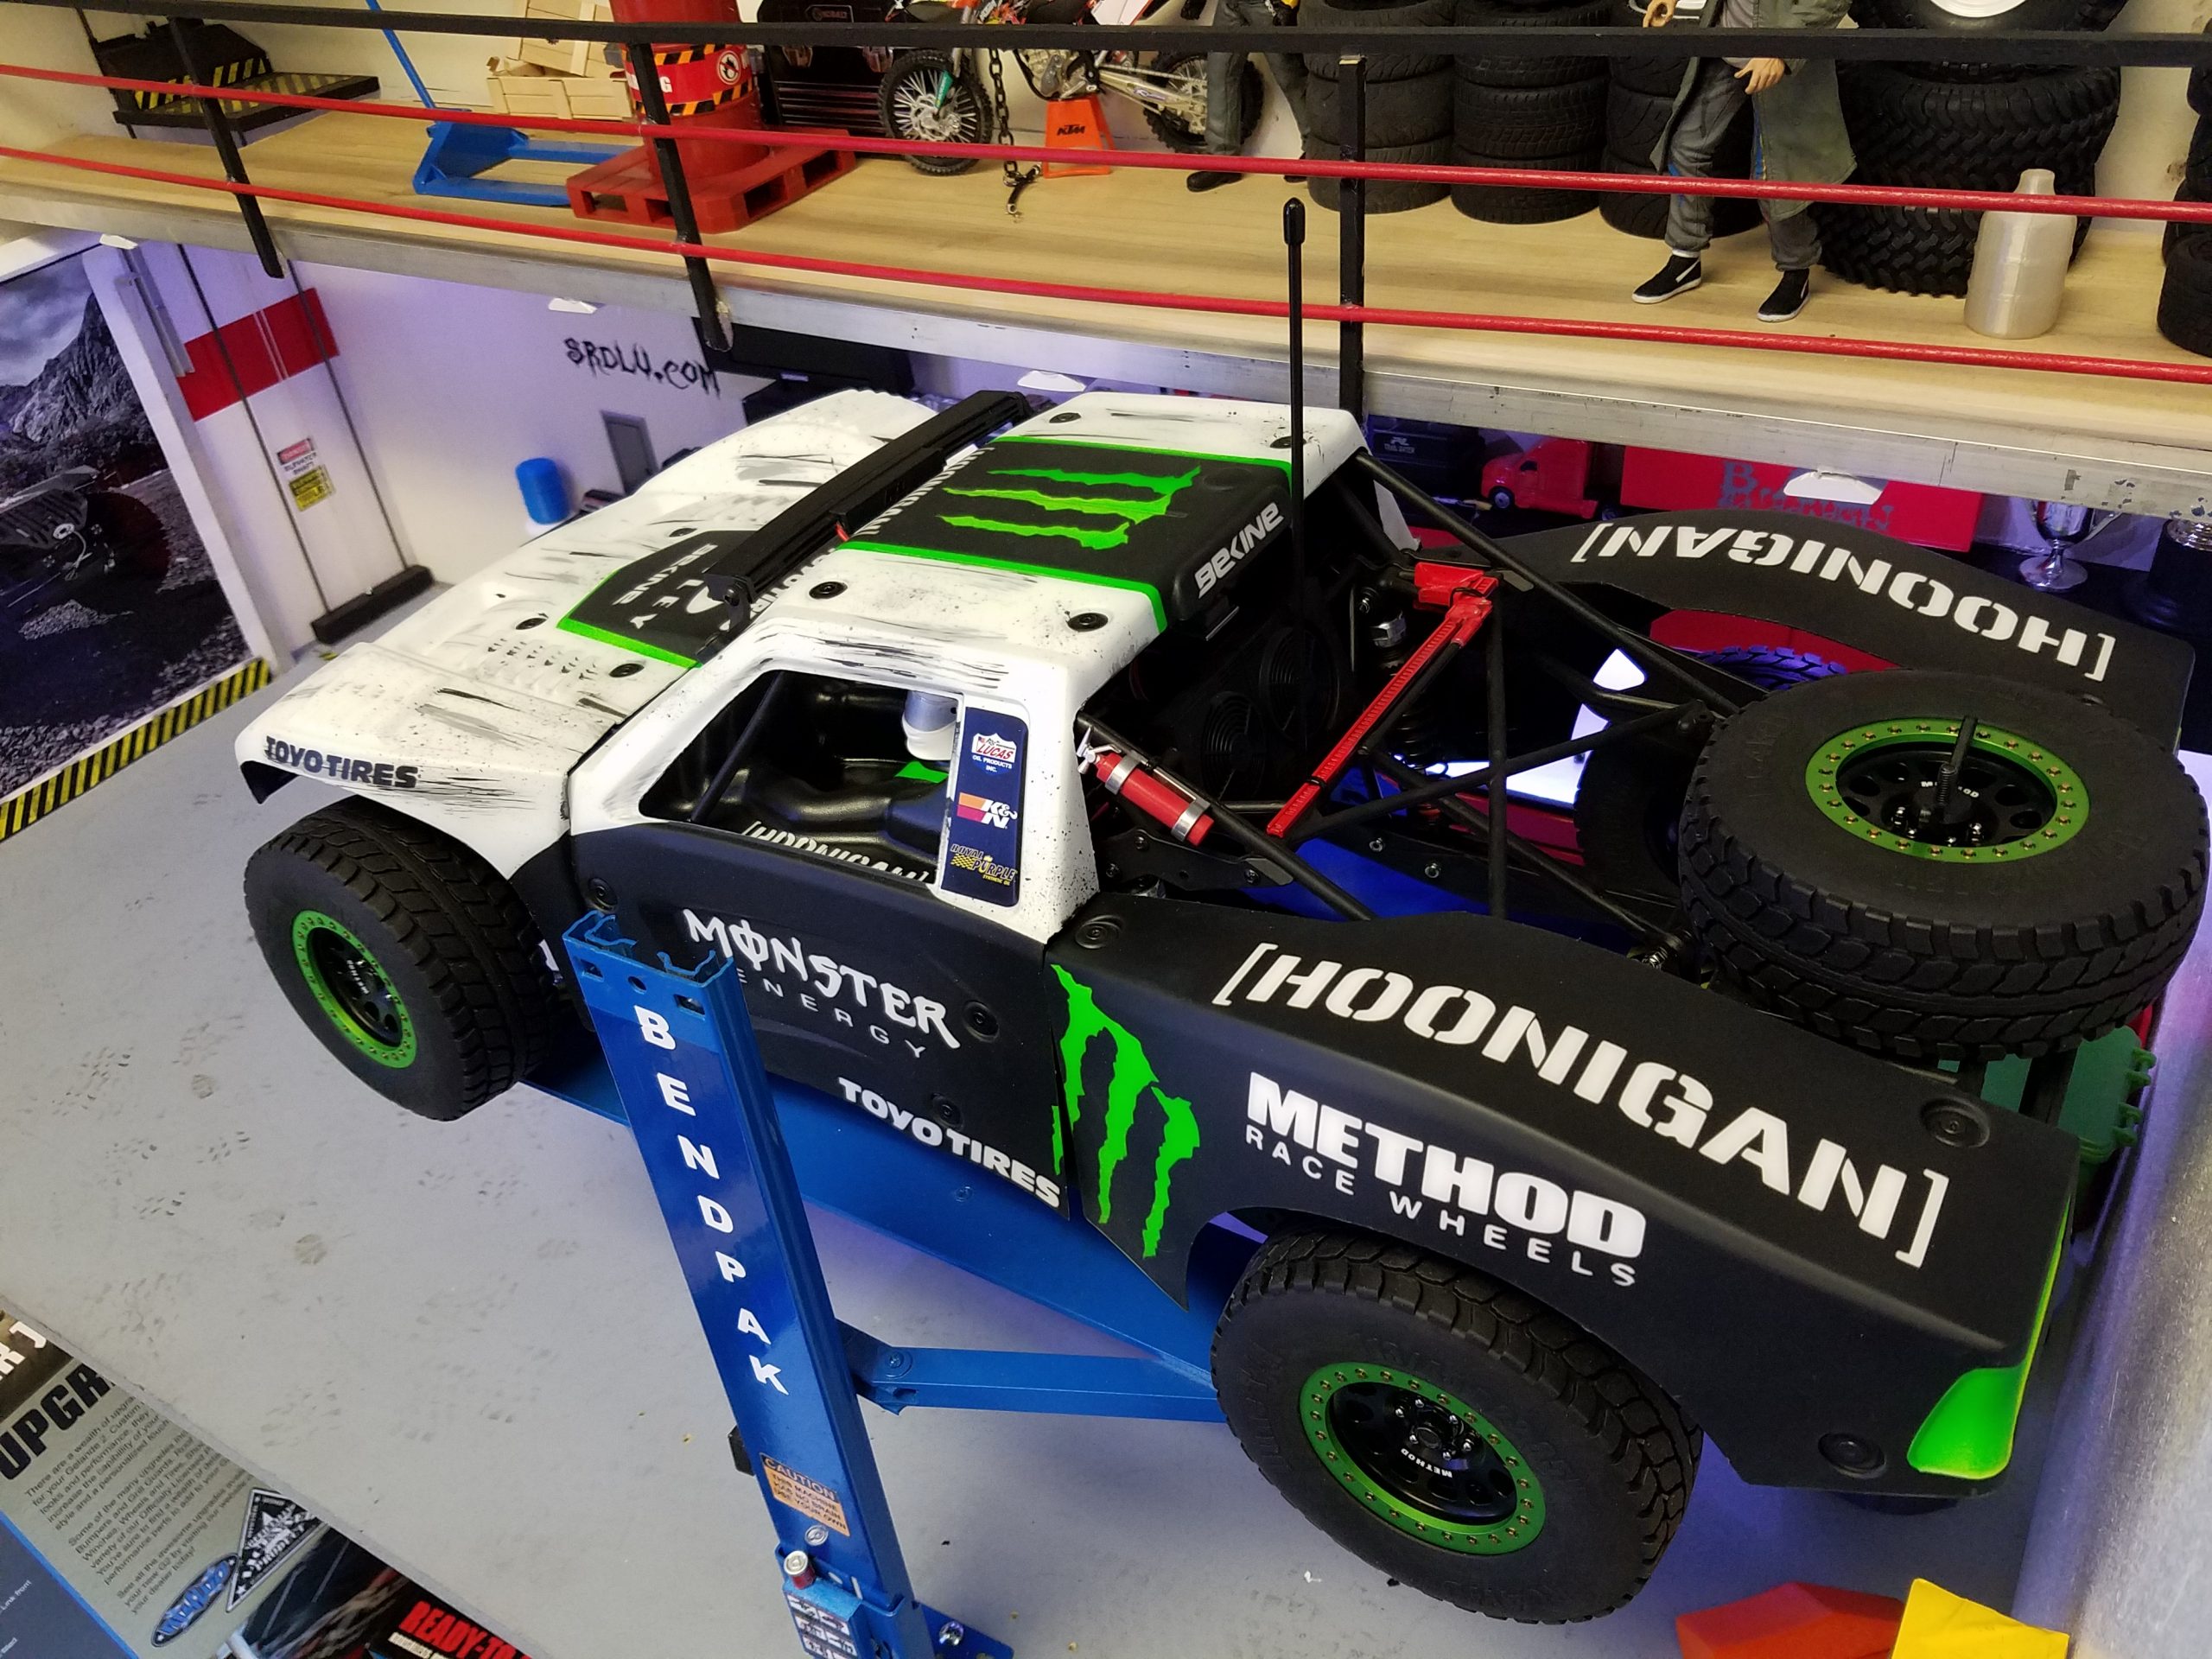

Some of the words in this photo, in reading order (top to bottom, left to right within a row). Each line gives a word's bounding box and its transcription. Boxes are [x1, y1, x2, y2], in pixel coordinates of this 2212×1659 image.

[1057, 124, 1085, 137] KTM
[976, 744, 1014, 760] LUCAS
[982, 757, 1012, 769] PRODUCTS
[982, 799, 1018, 829] K&N
[950, 843, 984, 860] ROYAL
[972, 855, 1017, 881] PURPLE
[683, 908, 961, 1048] MONSTER
[1247, 1071, 1647, 1259] METHOD
[633, 1005, 790, 1395] BENDPAK
[1245, 1124, 1355, 1195] RACE
[1389, 1195, 1637, 1287] WHEELS
[0, 1363, 116, 1480] UPGR
[1400, 1447, 1453, 1478] METHOD
[765, 1457, 836, 1500] CAUTION
